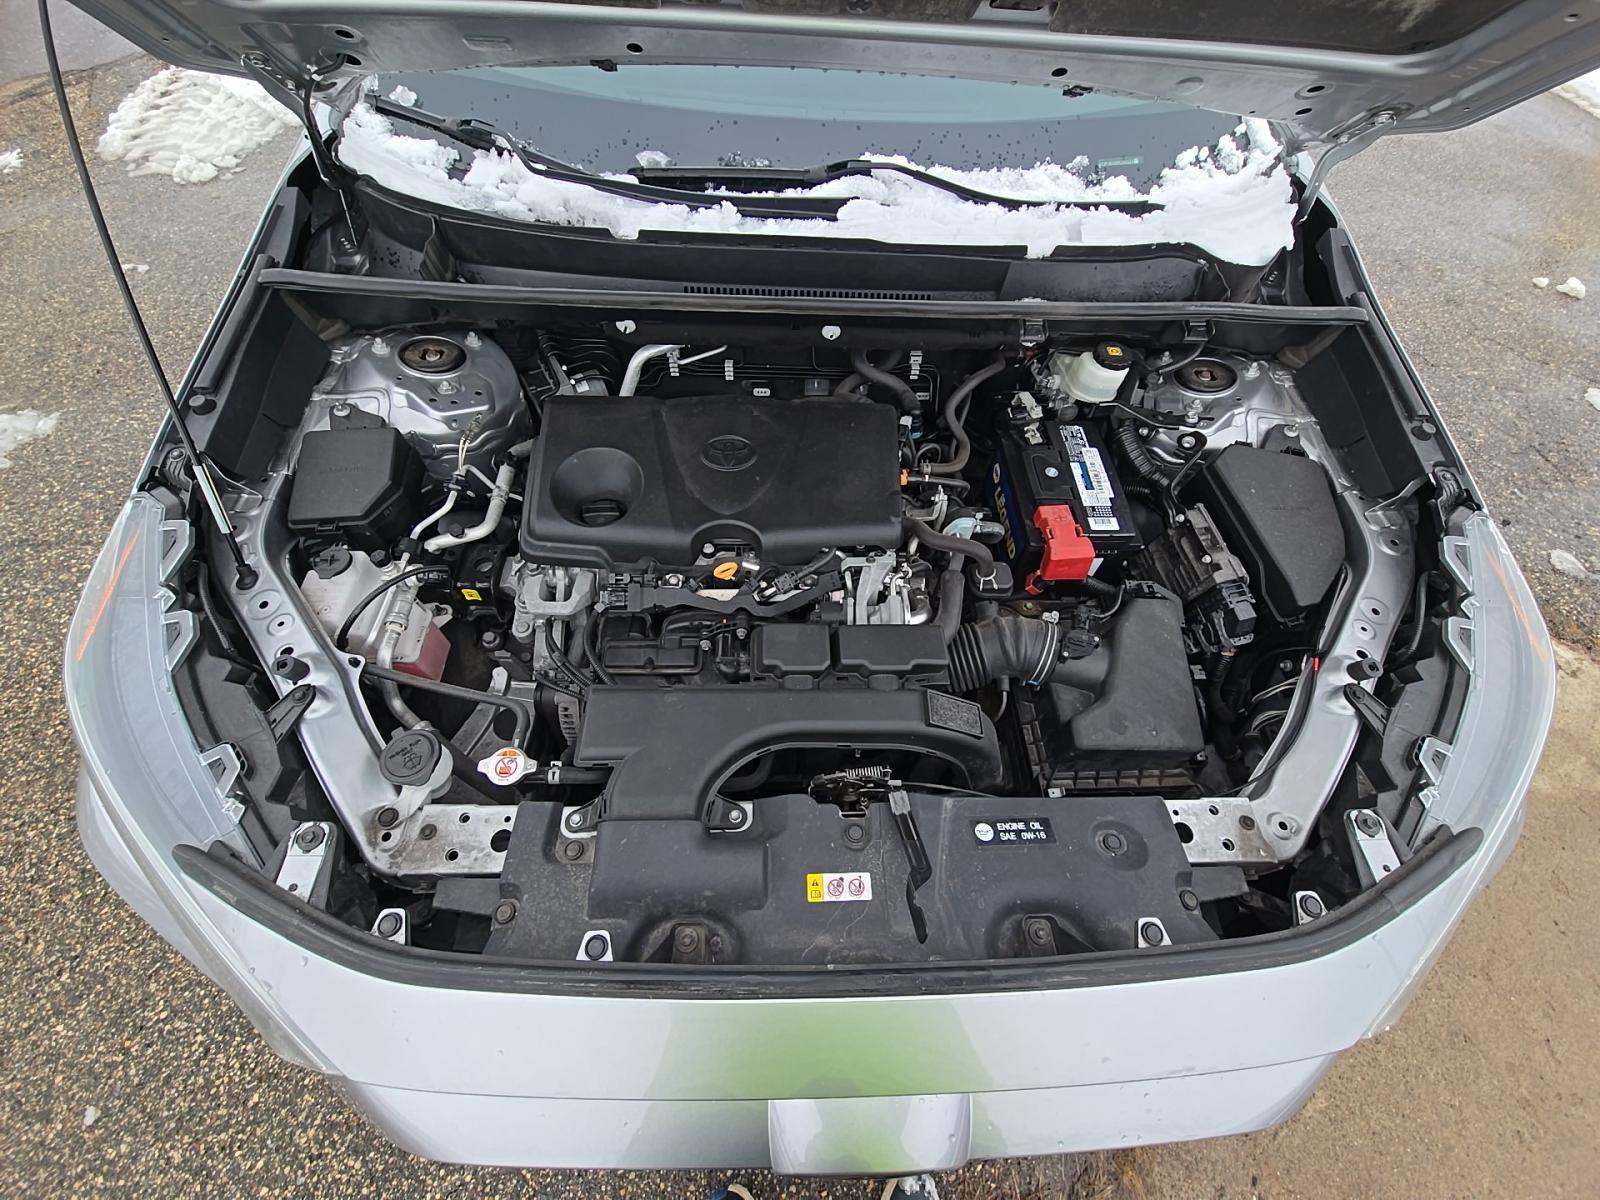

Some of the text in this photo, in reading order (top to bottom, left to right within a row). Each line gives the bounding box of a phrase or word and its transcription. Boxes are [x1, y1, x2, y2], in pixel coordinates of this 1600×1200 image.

[996, 821, 1044, 831] ENGINE OIL
[1000, 831, 1018, 841] SAE
